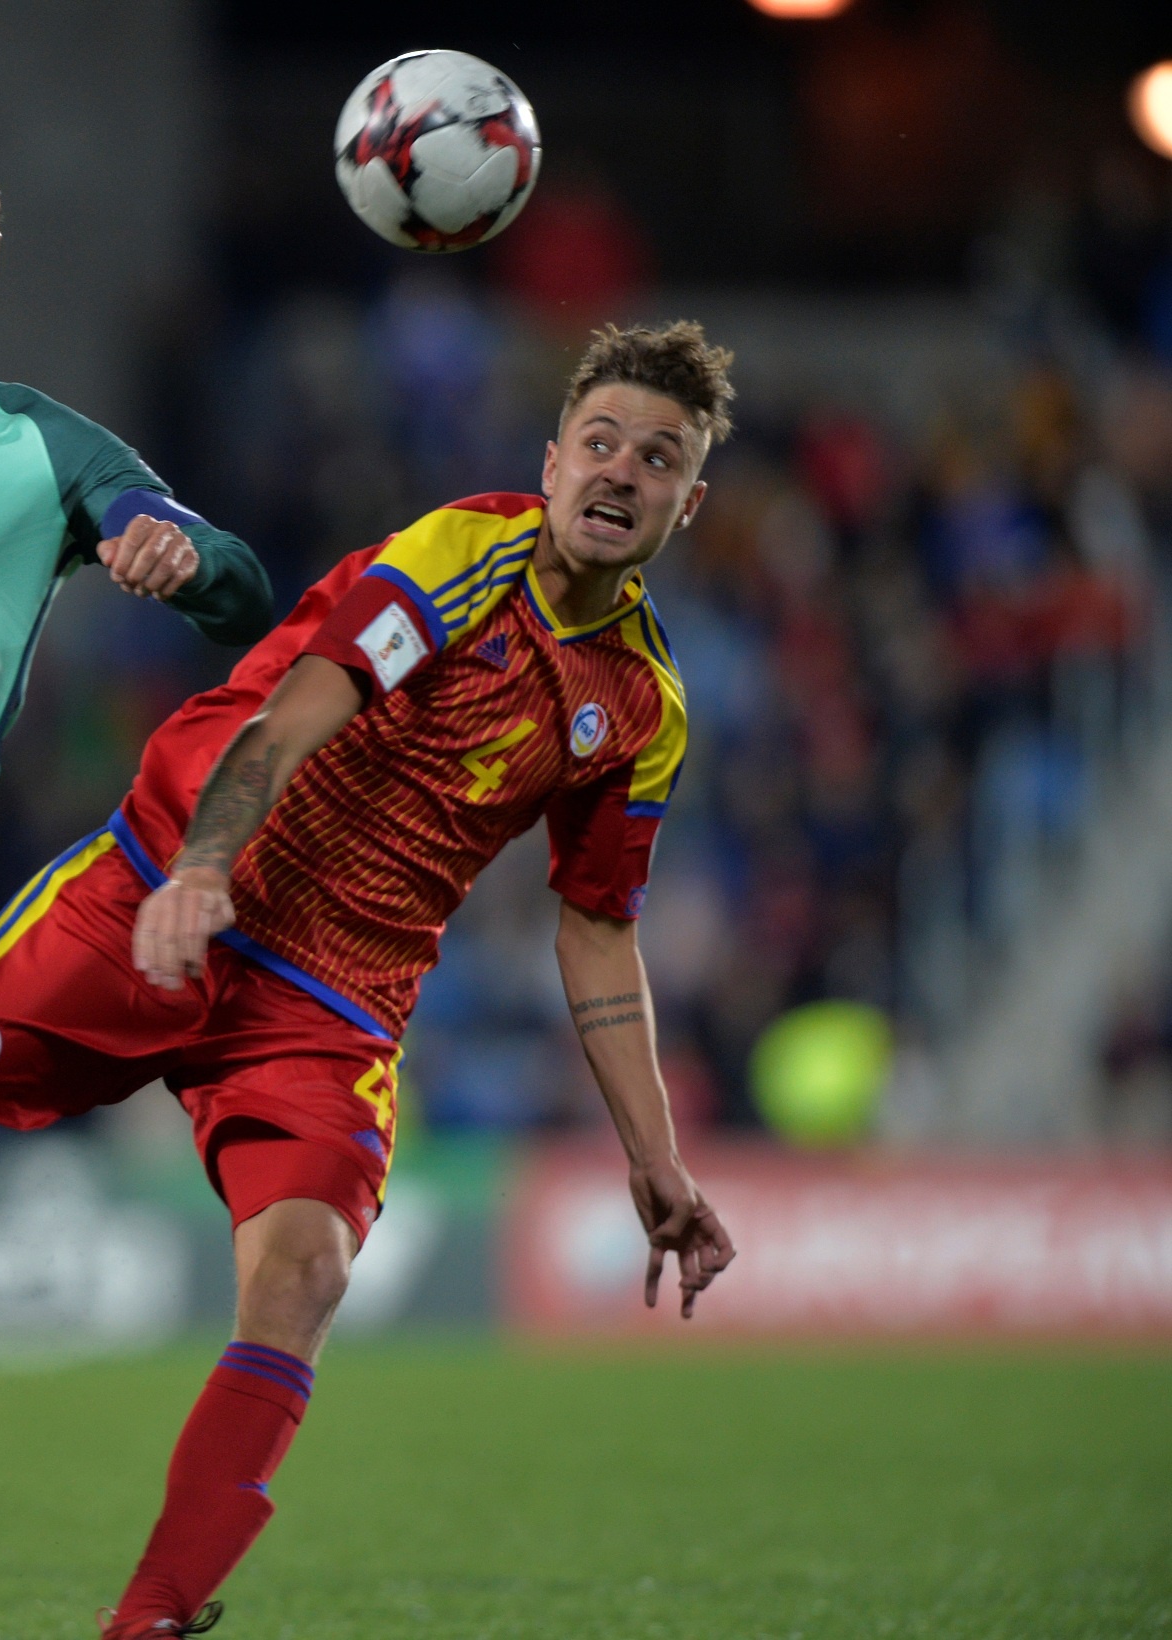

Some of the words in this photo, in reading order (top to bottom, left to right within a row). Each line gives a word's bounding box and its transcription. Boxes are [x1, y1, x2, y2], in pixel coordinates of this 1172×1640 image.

[459, 718, 538, 802] 4
[579, 721, 595, 738] FAF
[353, 1057, 392, 1131] 4
